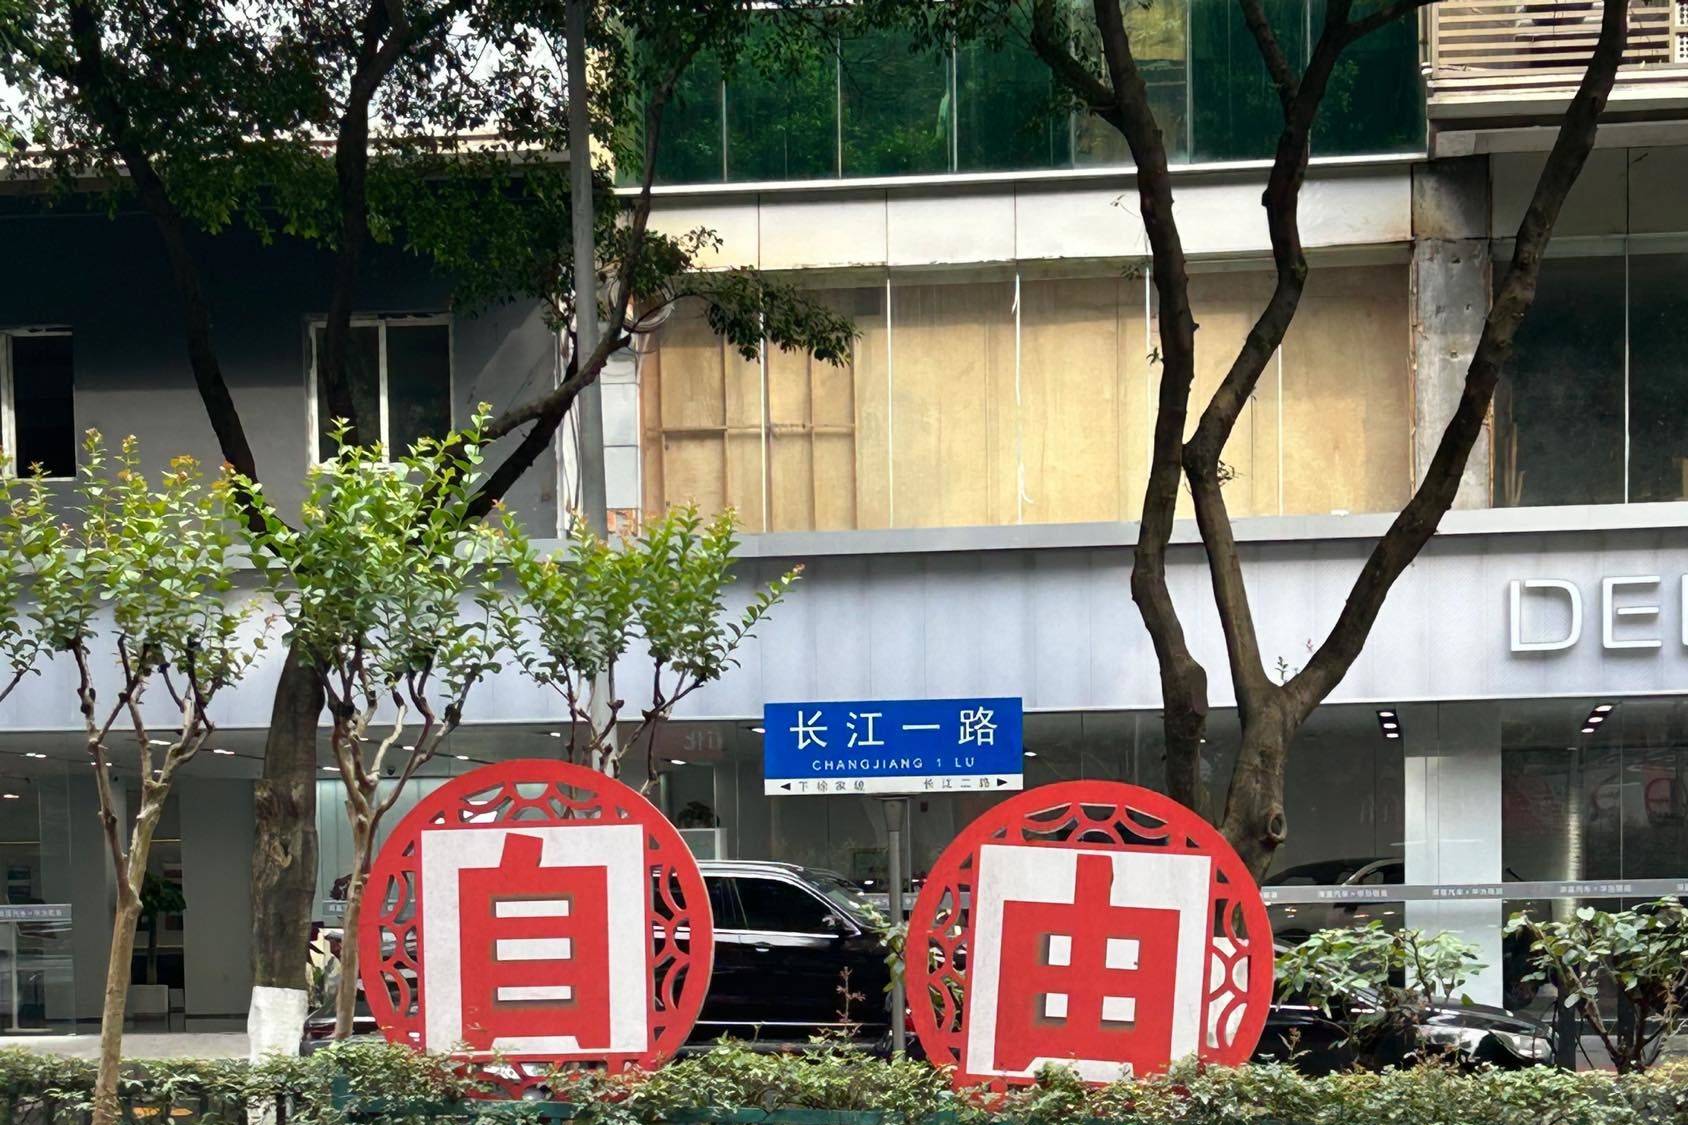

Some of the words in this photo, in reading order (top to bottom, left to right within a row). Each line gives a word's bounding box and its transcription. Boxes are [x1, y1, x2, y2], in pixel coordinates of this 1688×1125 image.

[1510, 574, 1688, 651] DE
[789, 705, 999, 750] 长江一路
[812, 757, 923, 771] CHANGJIANG
[955, 757, 975, 768] LU
[457, 831, 613, 1050] 自
[992, 853, 1182, 1076] 由
